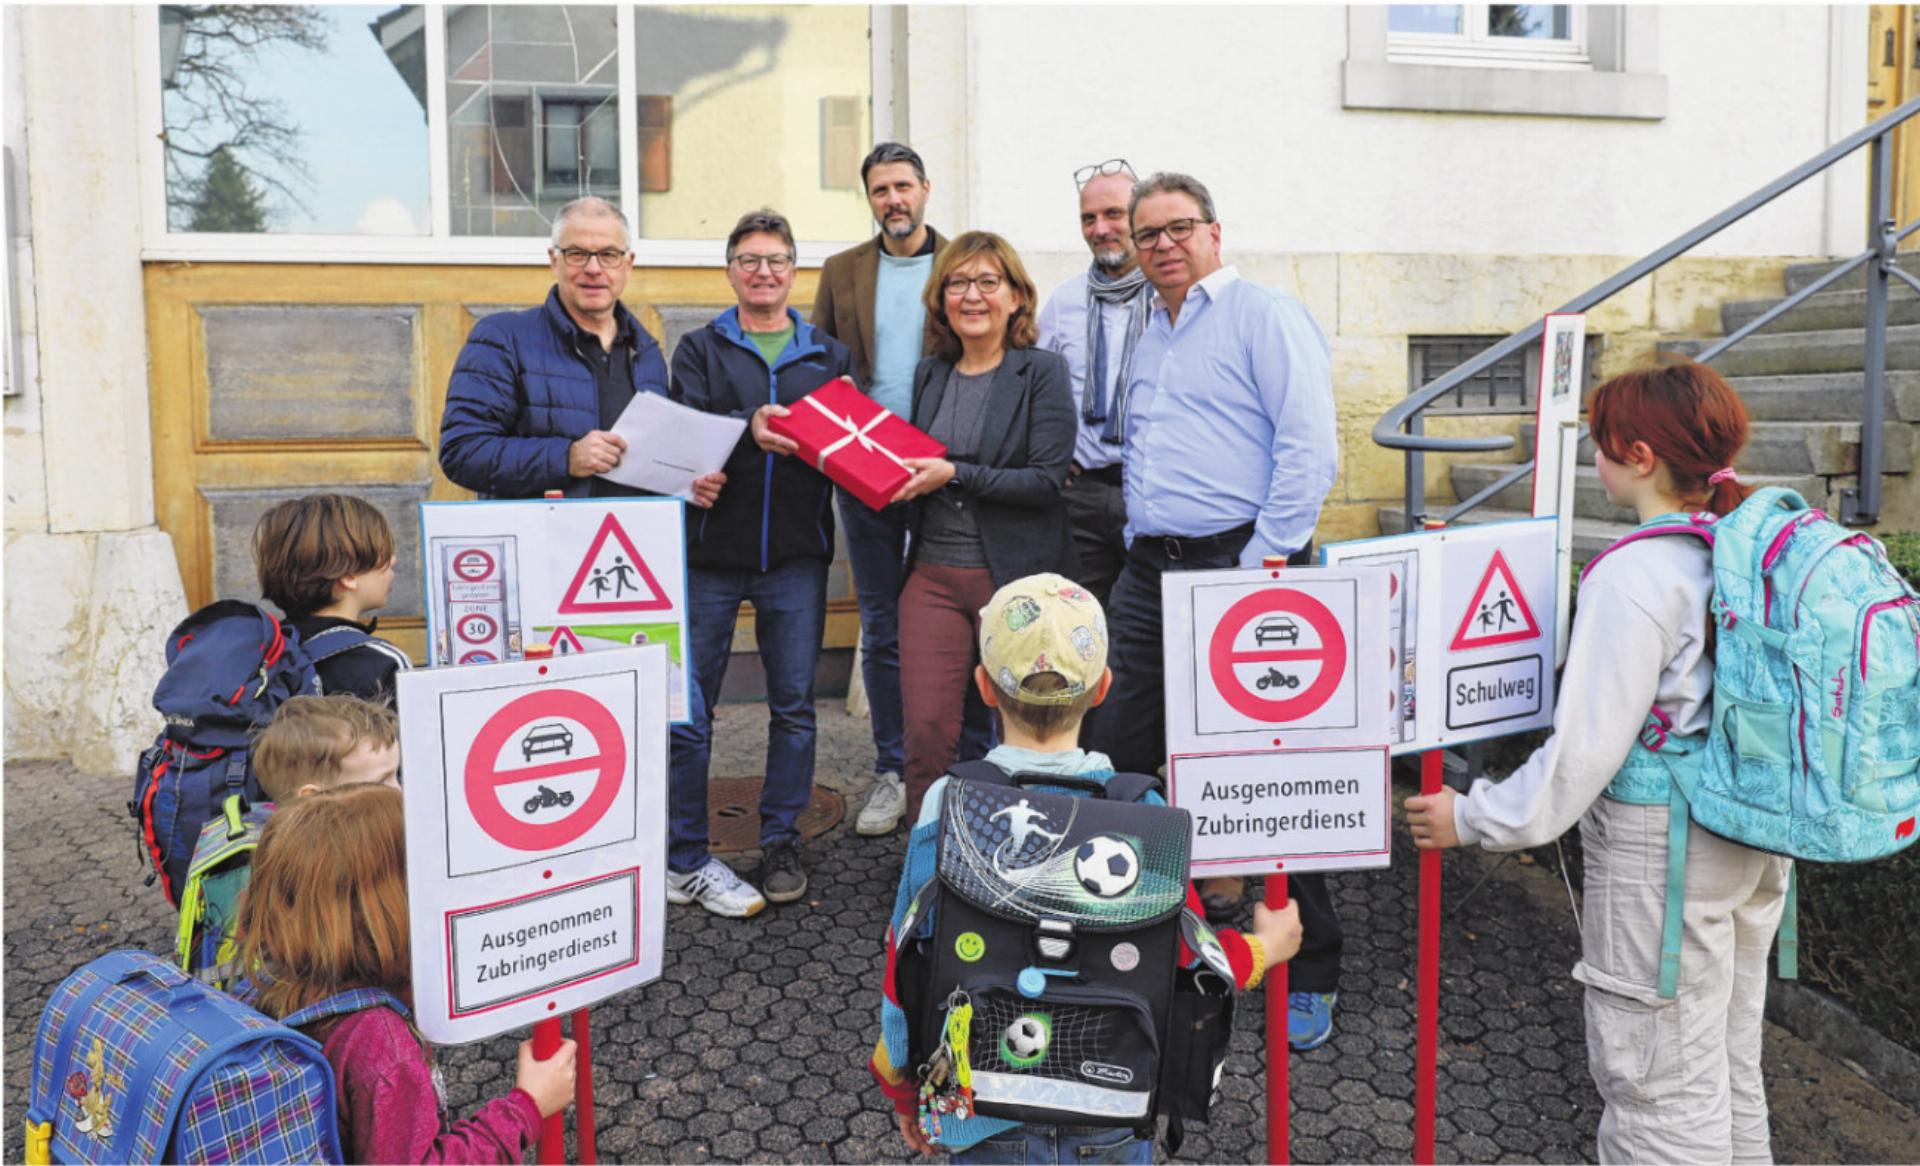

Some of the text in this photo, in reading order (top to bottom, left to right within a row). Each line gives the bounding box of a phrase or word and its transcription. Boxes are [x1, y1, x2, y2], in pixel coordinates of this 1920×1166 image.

[468, 622, 486, 636] 30
[1456, 677, 1535, 706] Schulweg
[1200, 778, 1360, 804] Ausgenommen
[1196, 809, 1367, 838] Zubringerdienst
[480, 904, 613, 952] Ausgenommen
[476, 929, 618, 983] Zubringerdienst
